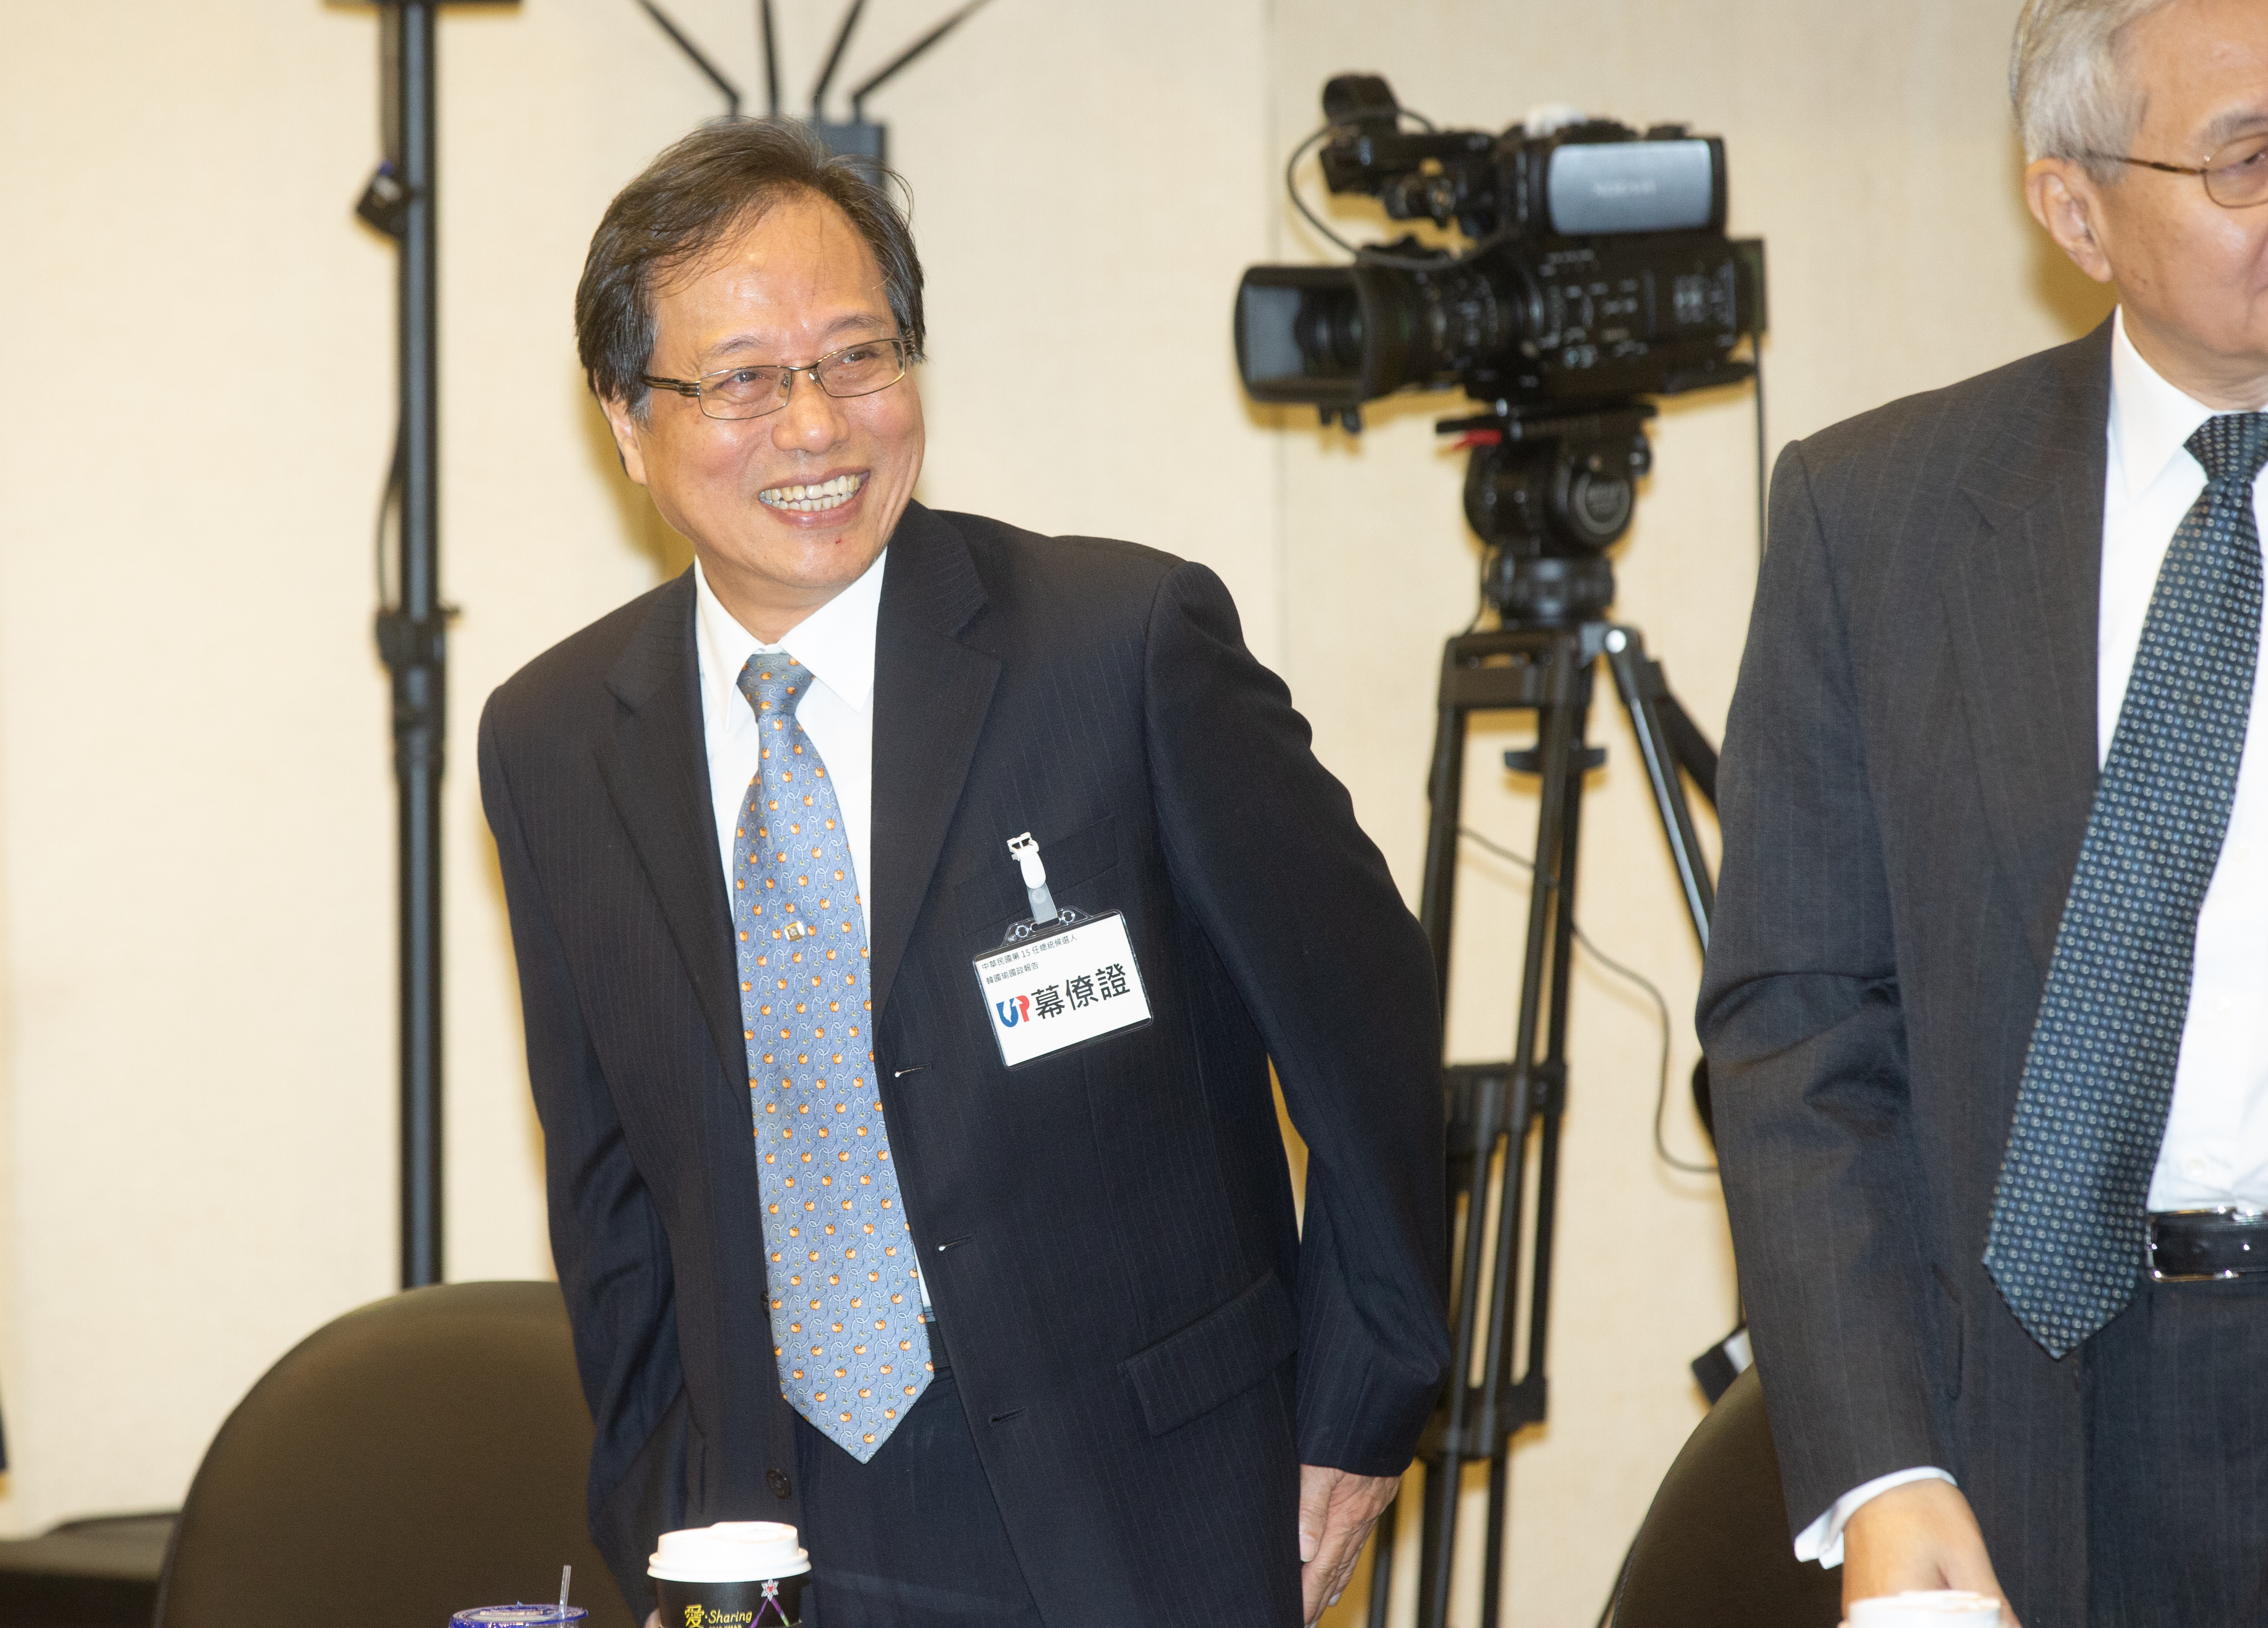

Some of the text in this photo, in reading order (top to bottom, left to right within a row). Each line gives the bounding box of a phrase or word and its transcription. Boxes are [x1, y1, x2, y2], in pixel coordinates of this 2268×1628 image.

[982, 934, 1077, 970] 中華民國第 15 任總統候選人
[986, 962, 1039, 985] 韓國瑜國政報告
[1031, 963, 1130, 1019] 幕僚證
[996, 995, 1030, 1028] UP
[708, 1609, 752, 1624] Sharing
